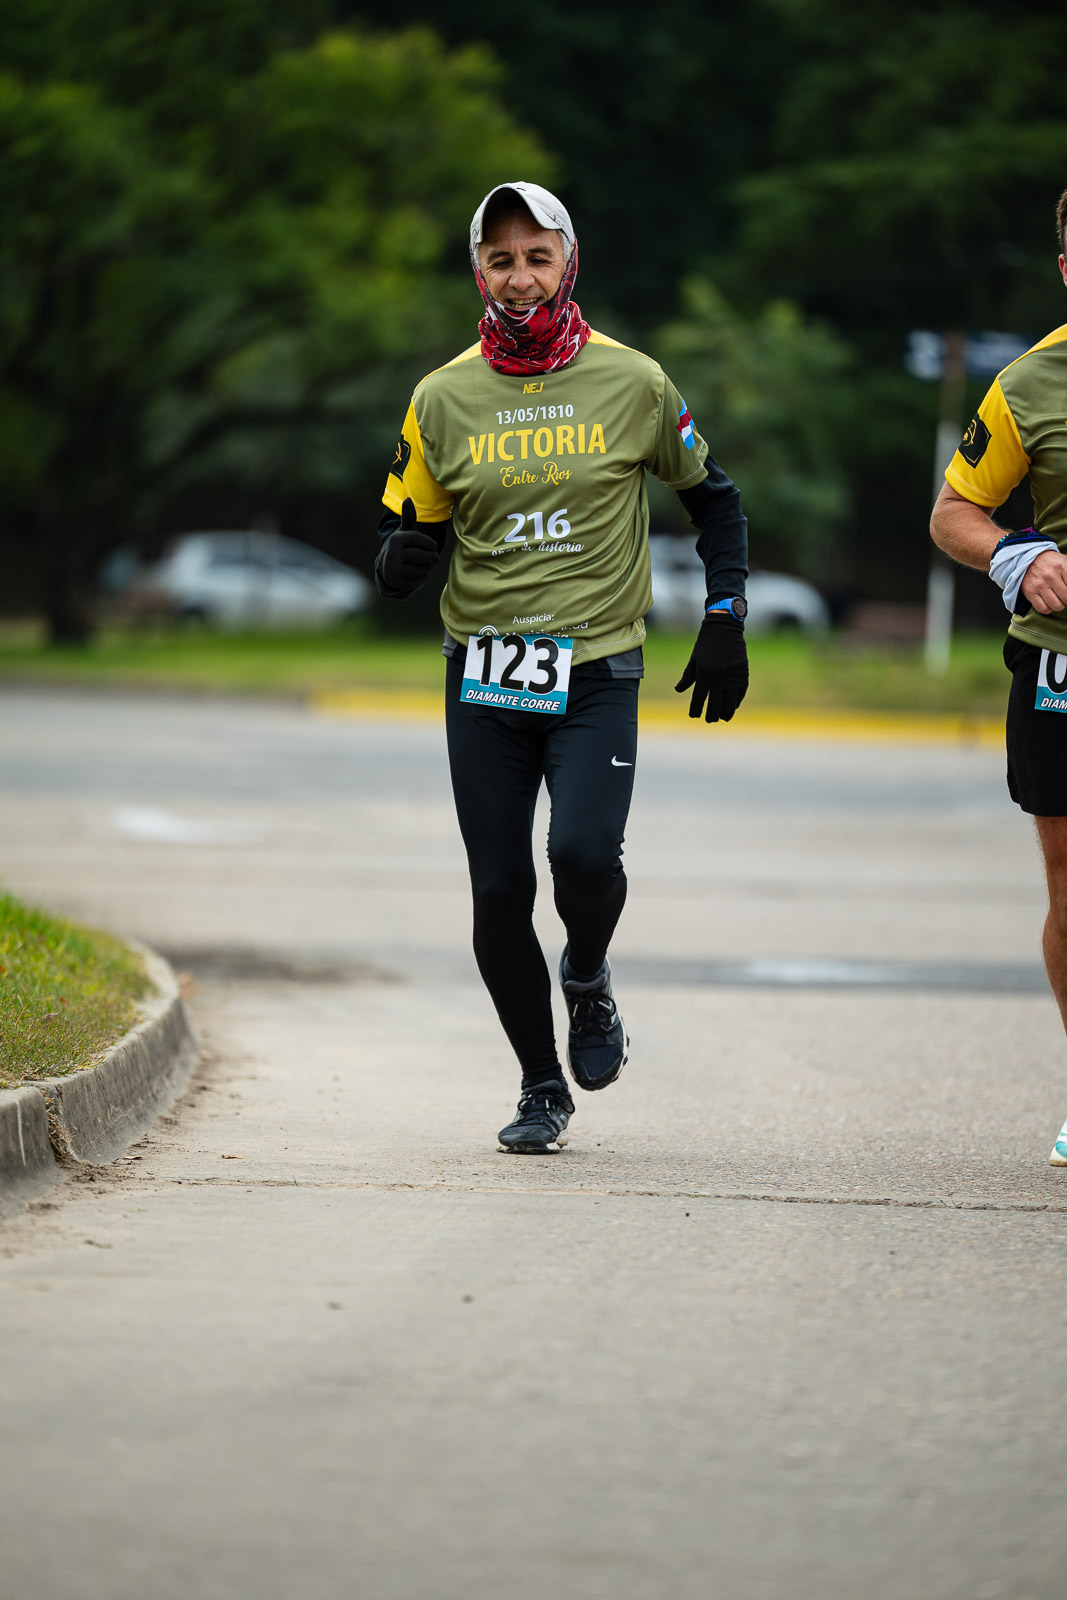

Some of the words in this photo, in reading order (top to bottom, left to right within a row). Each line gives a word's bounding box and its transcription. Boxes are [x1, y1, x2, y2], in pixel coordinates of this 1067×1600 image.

[523, 382, 544, 394] NEJ
[496, 404, 574, 424] 13/05/1810
[468, 423, 607, 465] VICTORIA
[500, 466, 539, 487] Entre
[504, 508, 571, 542] 216
[512, 613, 555, 625] Auspicia:
[476, 634, 559, 695] 123
[465, 689, 519, 707] DIAMANTE
[520, 696, 560, 711] CORRE
